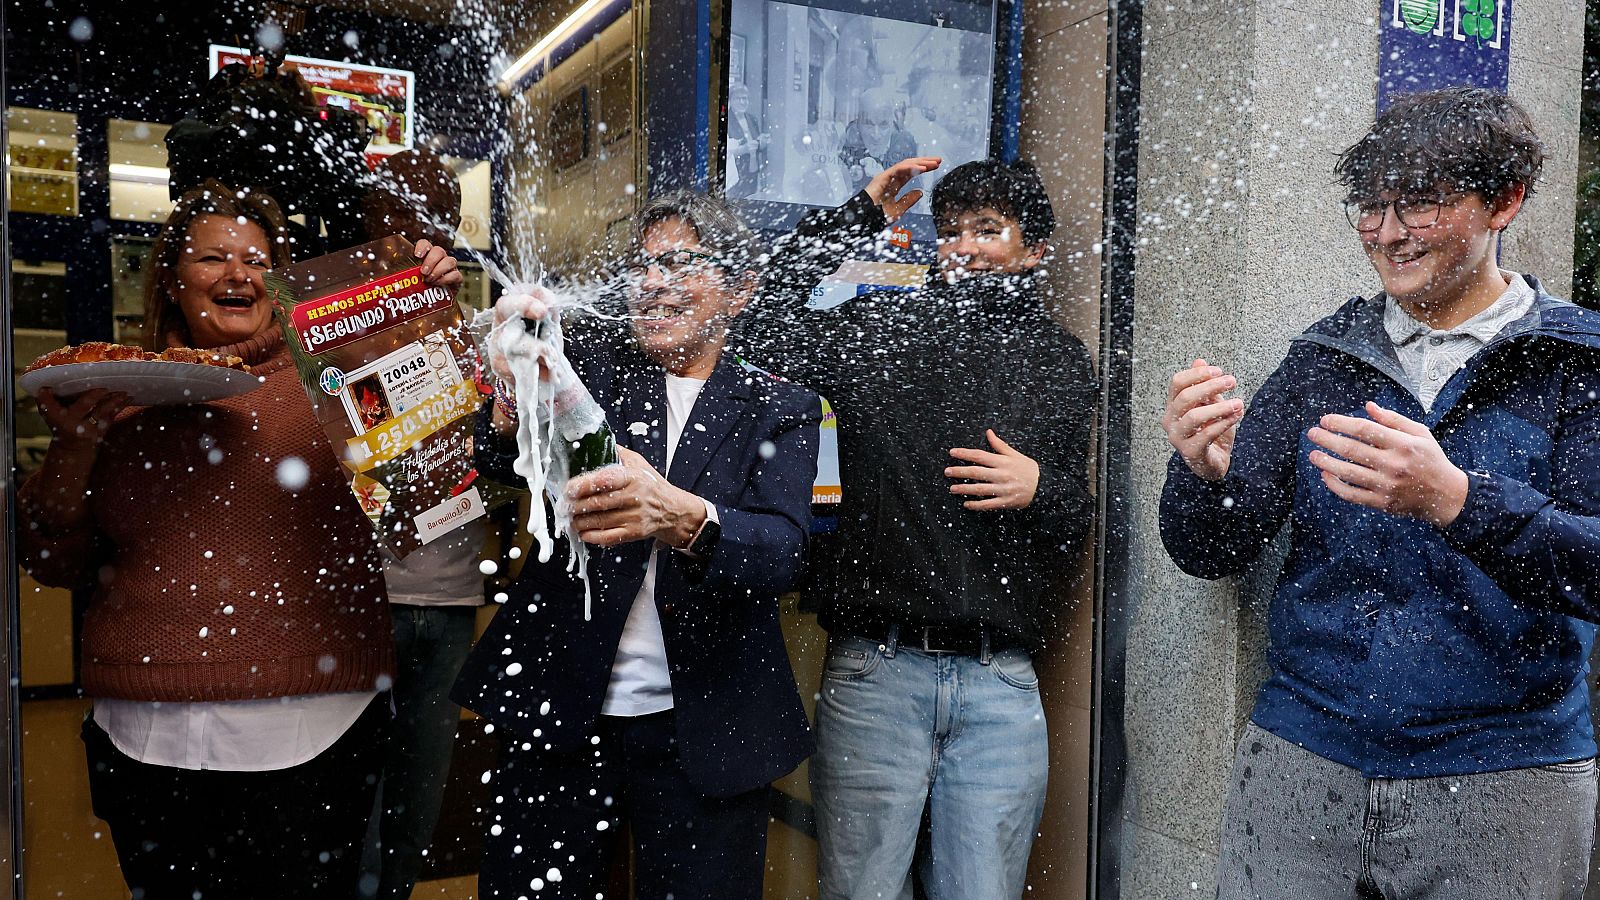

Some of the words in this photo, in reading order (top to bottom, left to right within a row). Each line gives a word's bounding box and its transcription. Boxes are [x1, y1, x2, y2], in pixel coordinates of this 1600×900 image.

[307, 296, 355, 321] HEMOS
[355, 275, 419, 304] REPARTIDO
[812, 286, 825, 297] ES
[303, 306, 385, 352] ¡SEGUNDO
[386, 286, 452, 319] PREMIO!
[383, 356, 426, 384] 70048
[409, 368, 432, 384] CIONAL
[407, 468, 420, 484] los
